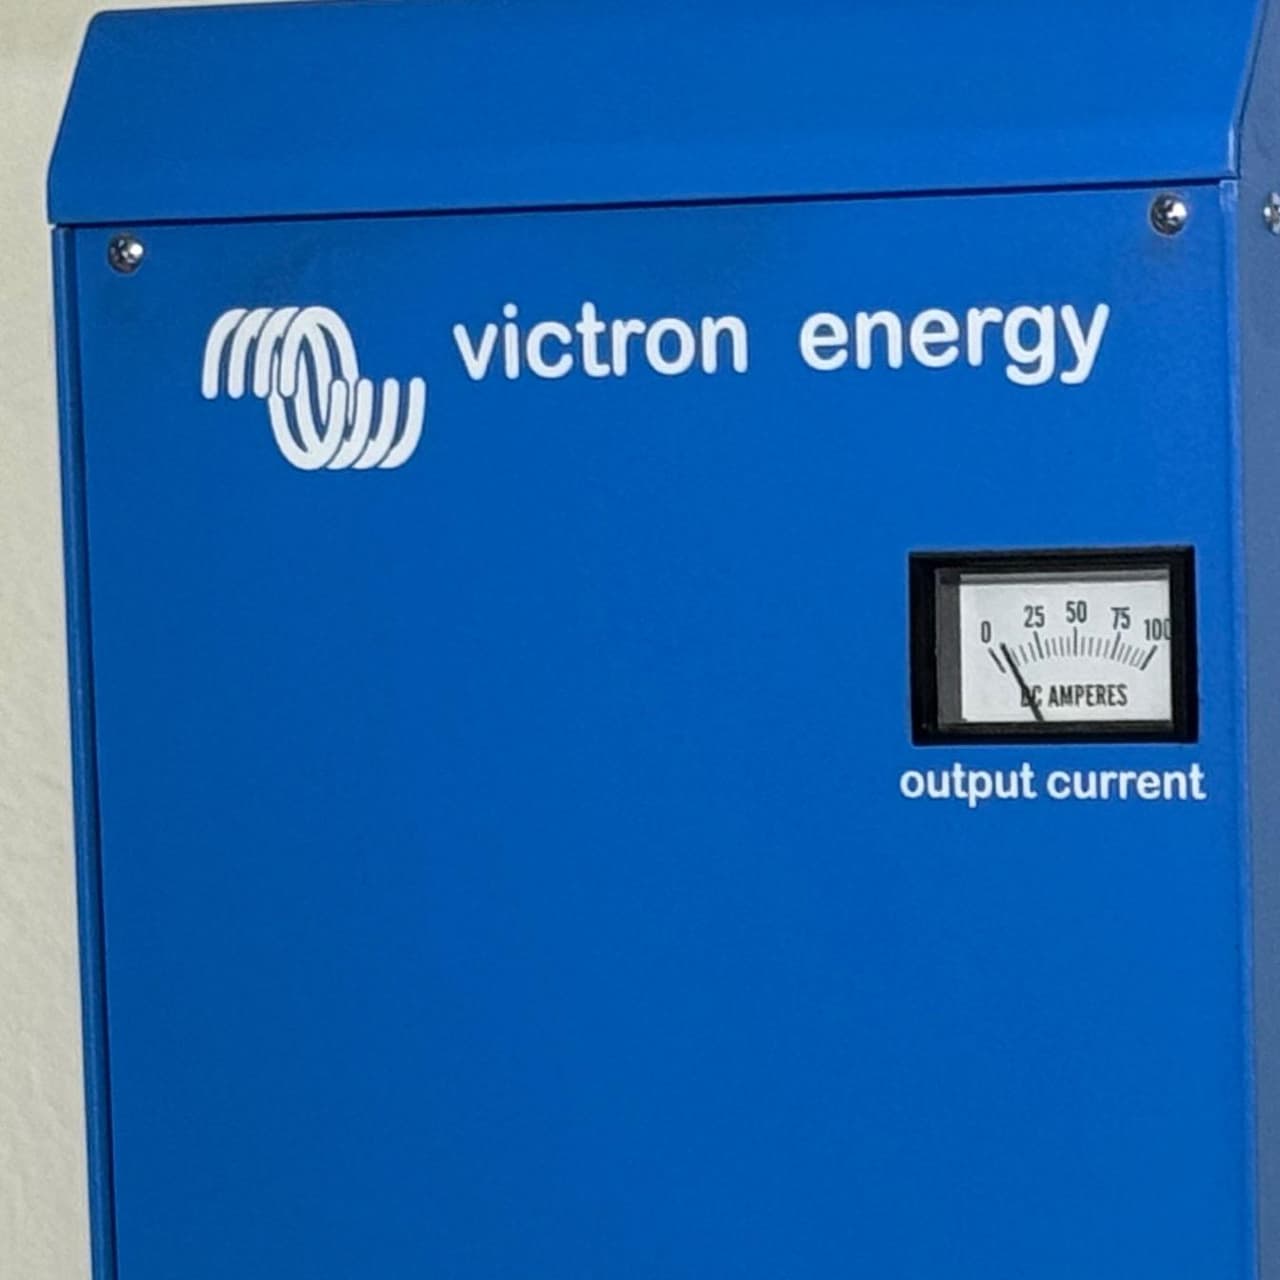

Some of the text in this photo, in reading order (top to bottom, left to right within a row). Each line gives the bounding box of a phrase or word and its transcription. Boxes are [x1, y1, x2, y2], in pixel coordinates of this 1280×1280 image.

[453, 301, 1110, 387] victron energy
[1023, 605, 1046, 628] 25
[1065, 600, 1088, 624] 50
[1110, 606, 1131, 630] 75
[980, 620, 991, 644] 0
[1047, 683, 1128, 708] AMPERES
[899, 761, 1207, 808] output current
